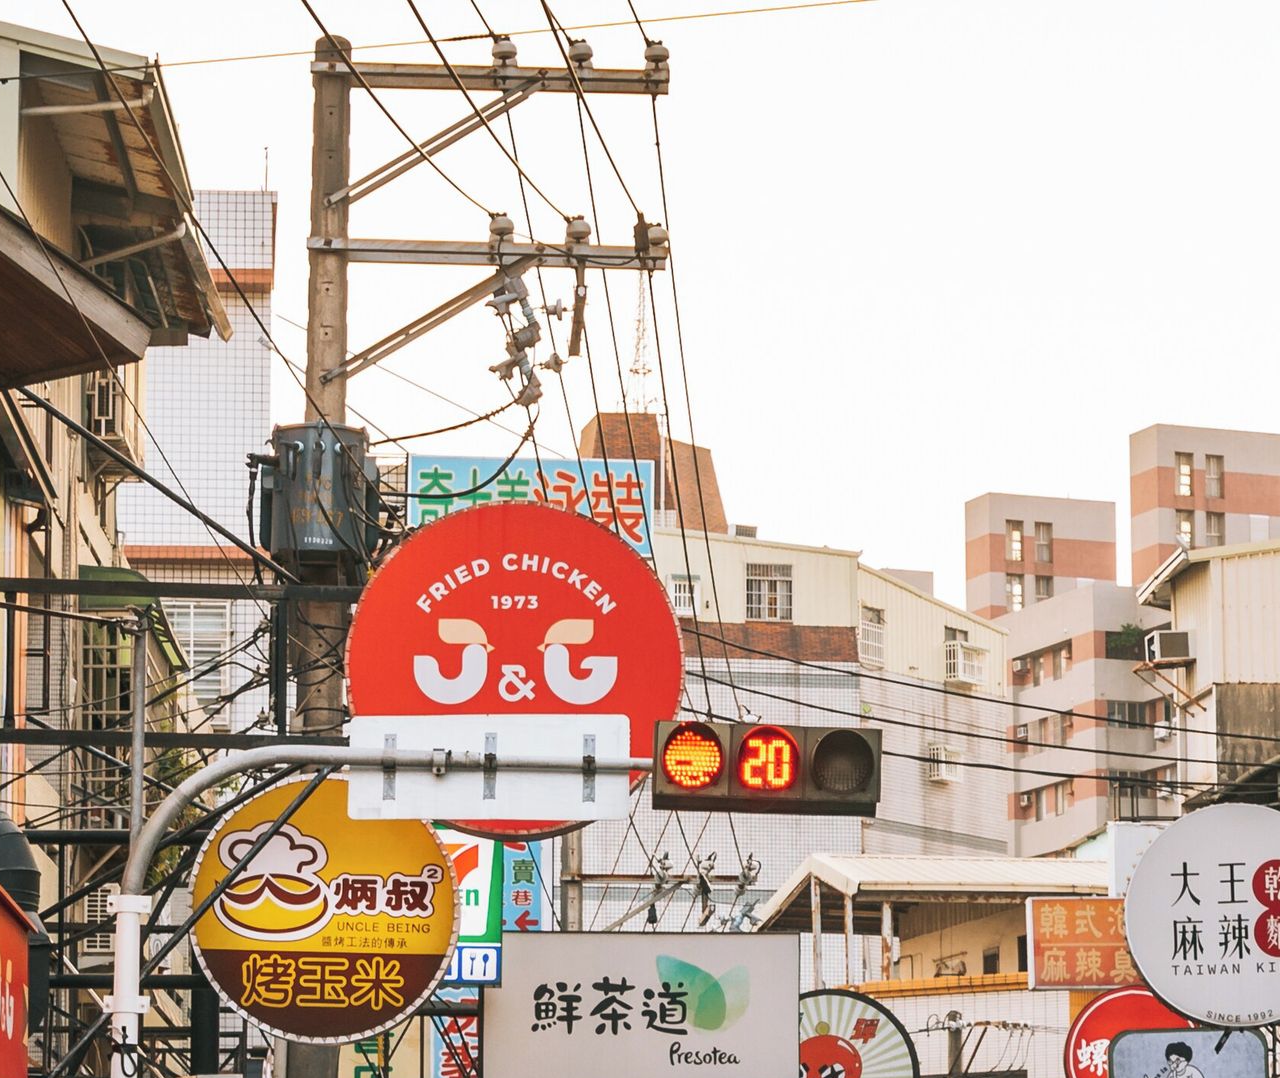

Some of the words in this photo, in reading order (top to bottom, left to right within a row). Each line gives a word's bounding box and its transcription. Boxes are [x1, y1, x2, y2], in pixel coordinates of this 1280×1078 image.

[416, 557, 491, 614] FRIED
[502, 553, 618, 615] CHICKEN
[491, 595, 539, 610] 1973
[414, 618, 618, 705] J&G
[743, 739, 791, 786] 20
[332, 876, 430, 913] 炳叔
[1170, 861, 1249, 906] 大王
[321, 936, 409, 949] 醬烤工法的傳承
[337, 922, 380, 933] UNCLE
[387, 922, 431, 935] BEING
[1171, 913, 1252, 961] 麻辣
[240, 953, 405, 1010] 烤玉米
[1171, 963, 1242, 976] TAIWAN
[531, 976, 689, 1036] 鮮茶道
[1206, 1009, 1242, 1023] SINCE
[1247, 1009, 1275, 1021] 1992
[669, 1041, 741, 1066] Presotea
